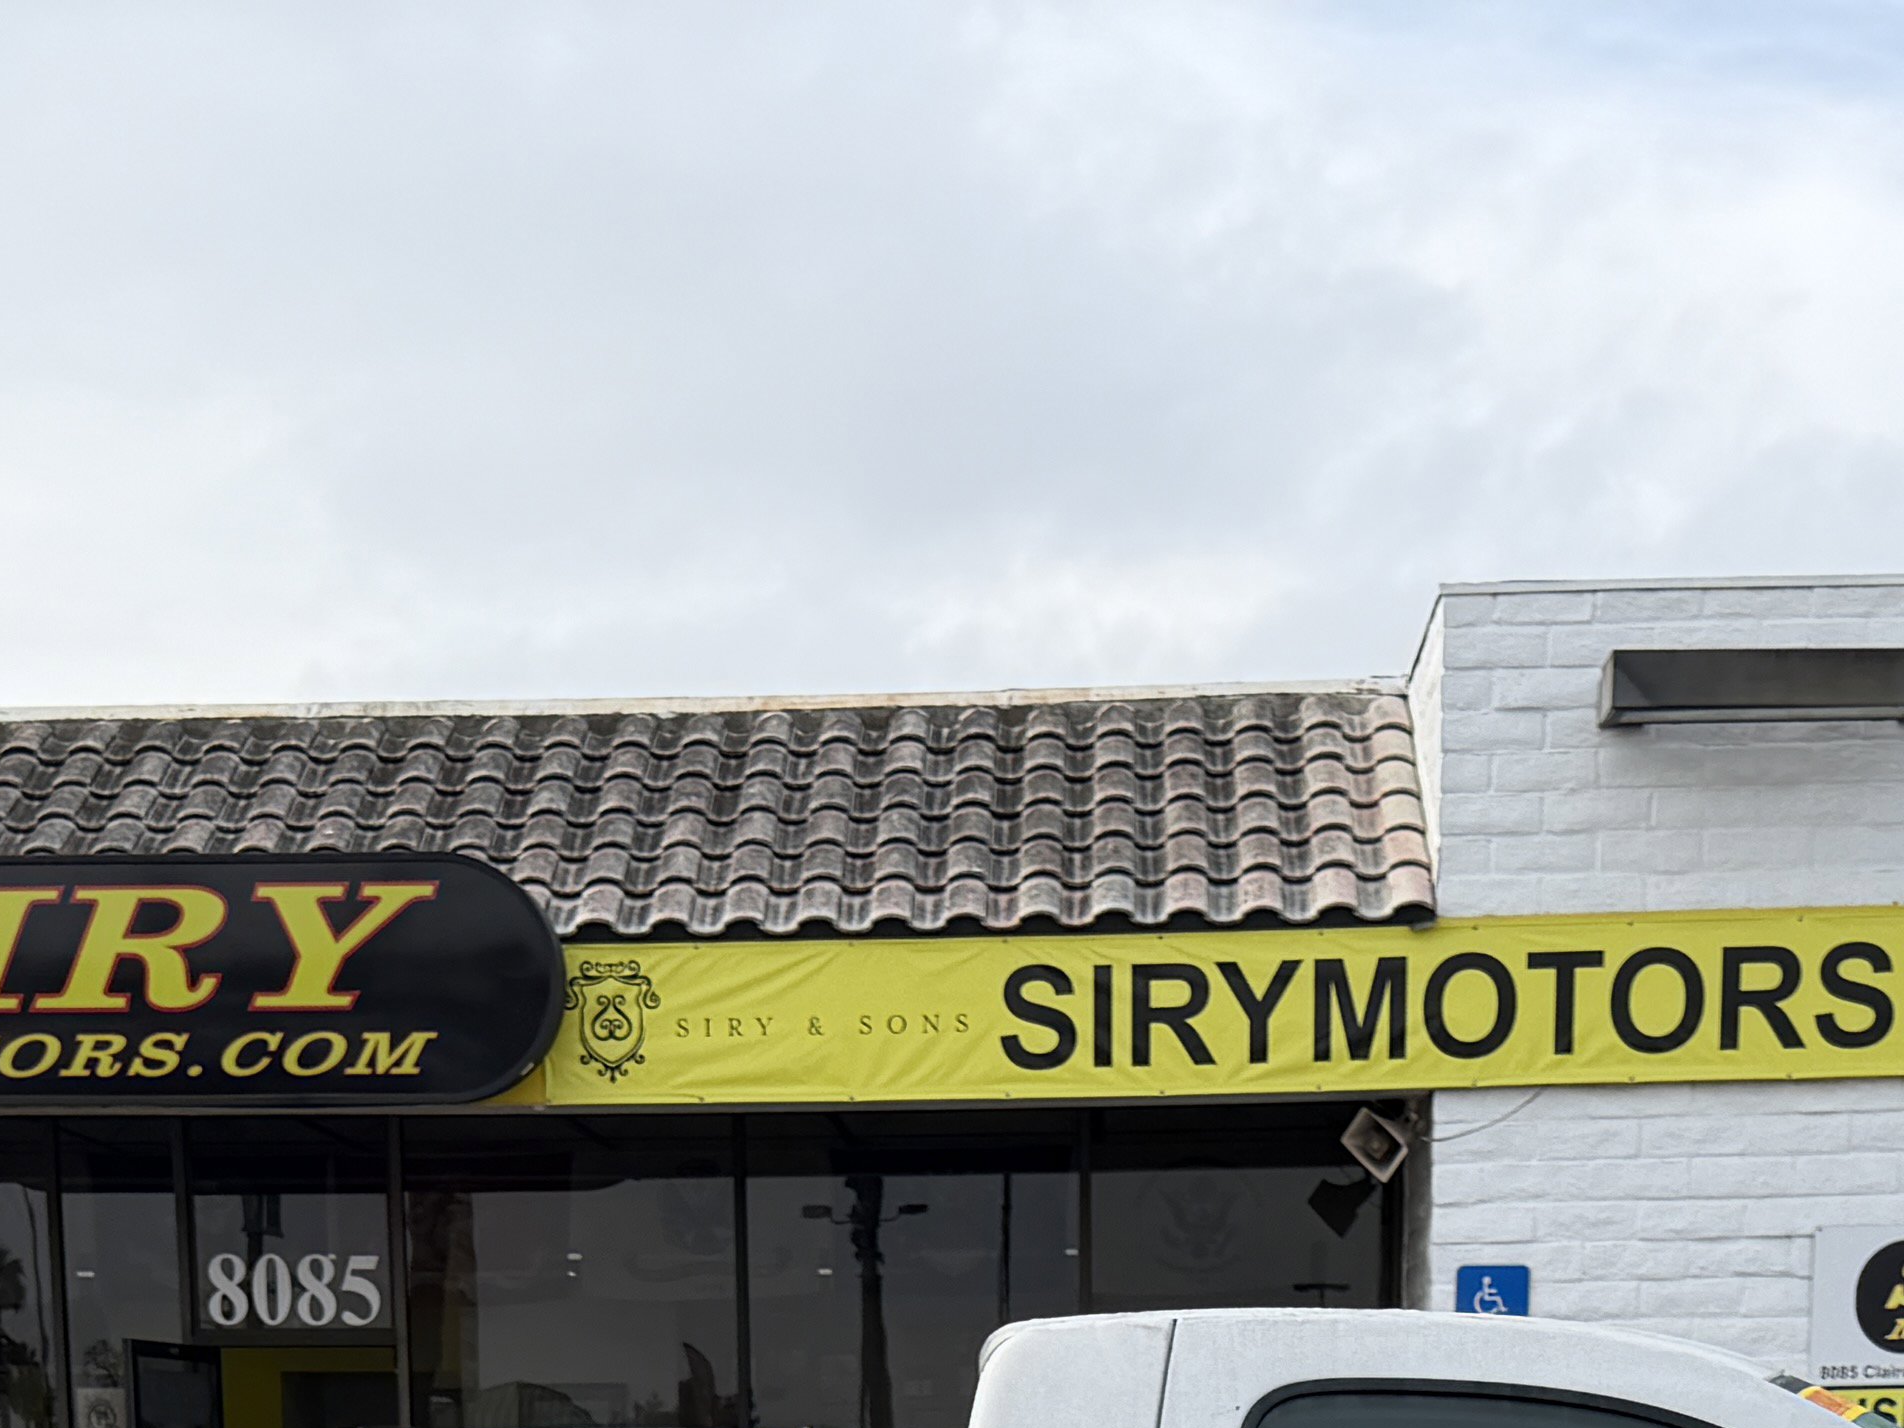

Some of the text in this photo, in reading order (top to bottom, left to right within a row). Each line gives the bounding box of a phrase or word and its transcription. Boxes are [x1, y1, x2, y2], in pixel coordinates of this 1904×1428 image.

[676, 1013, 971, 1039] SIRY & SONS
[207, 1253, 382, 1327] 8085
